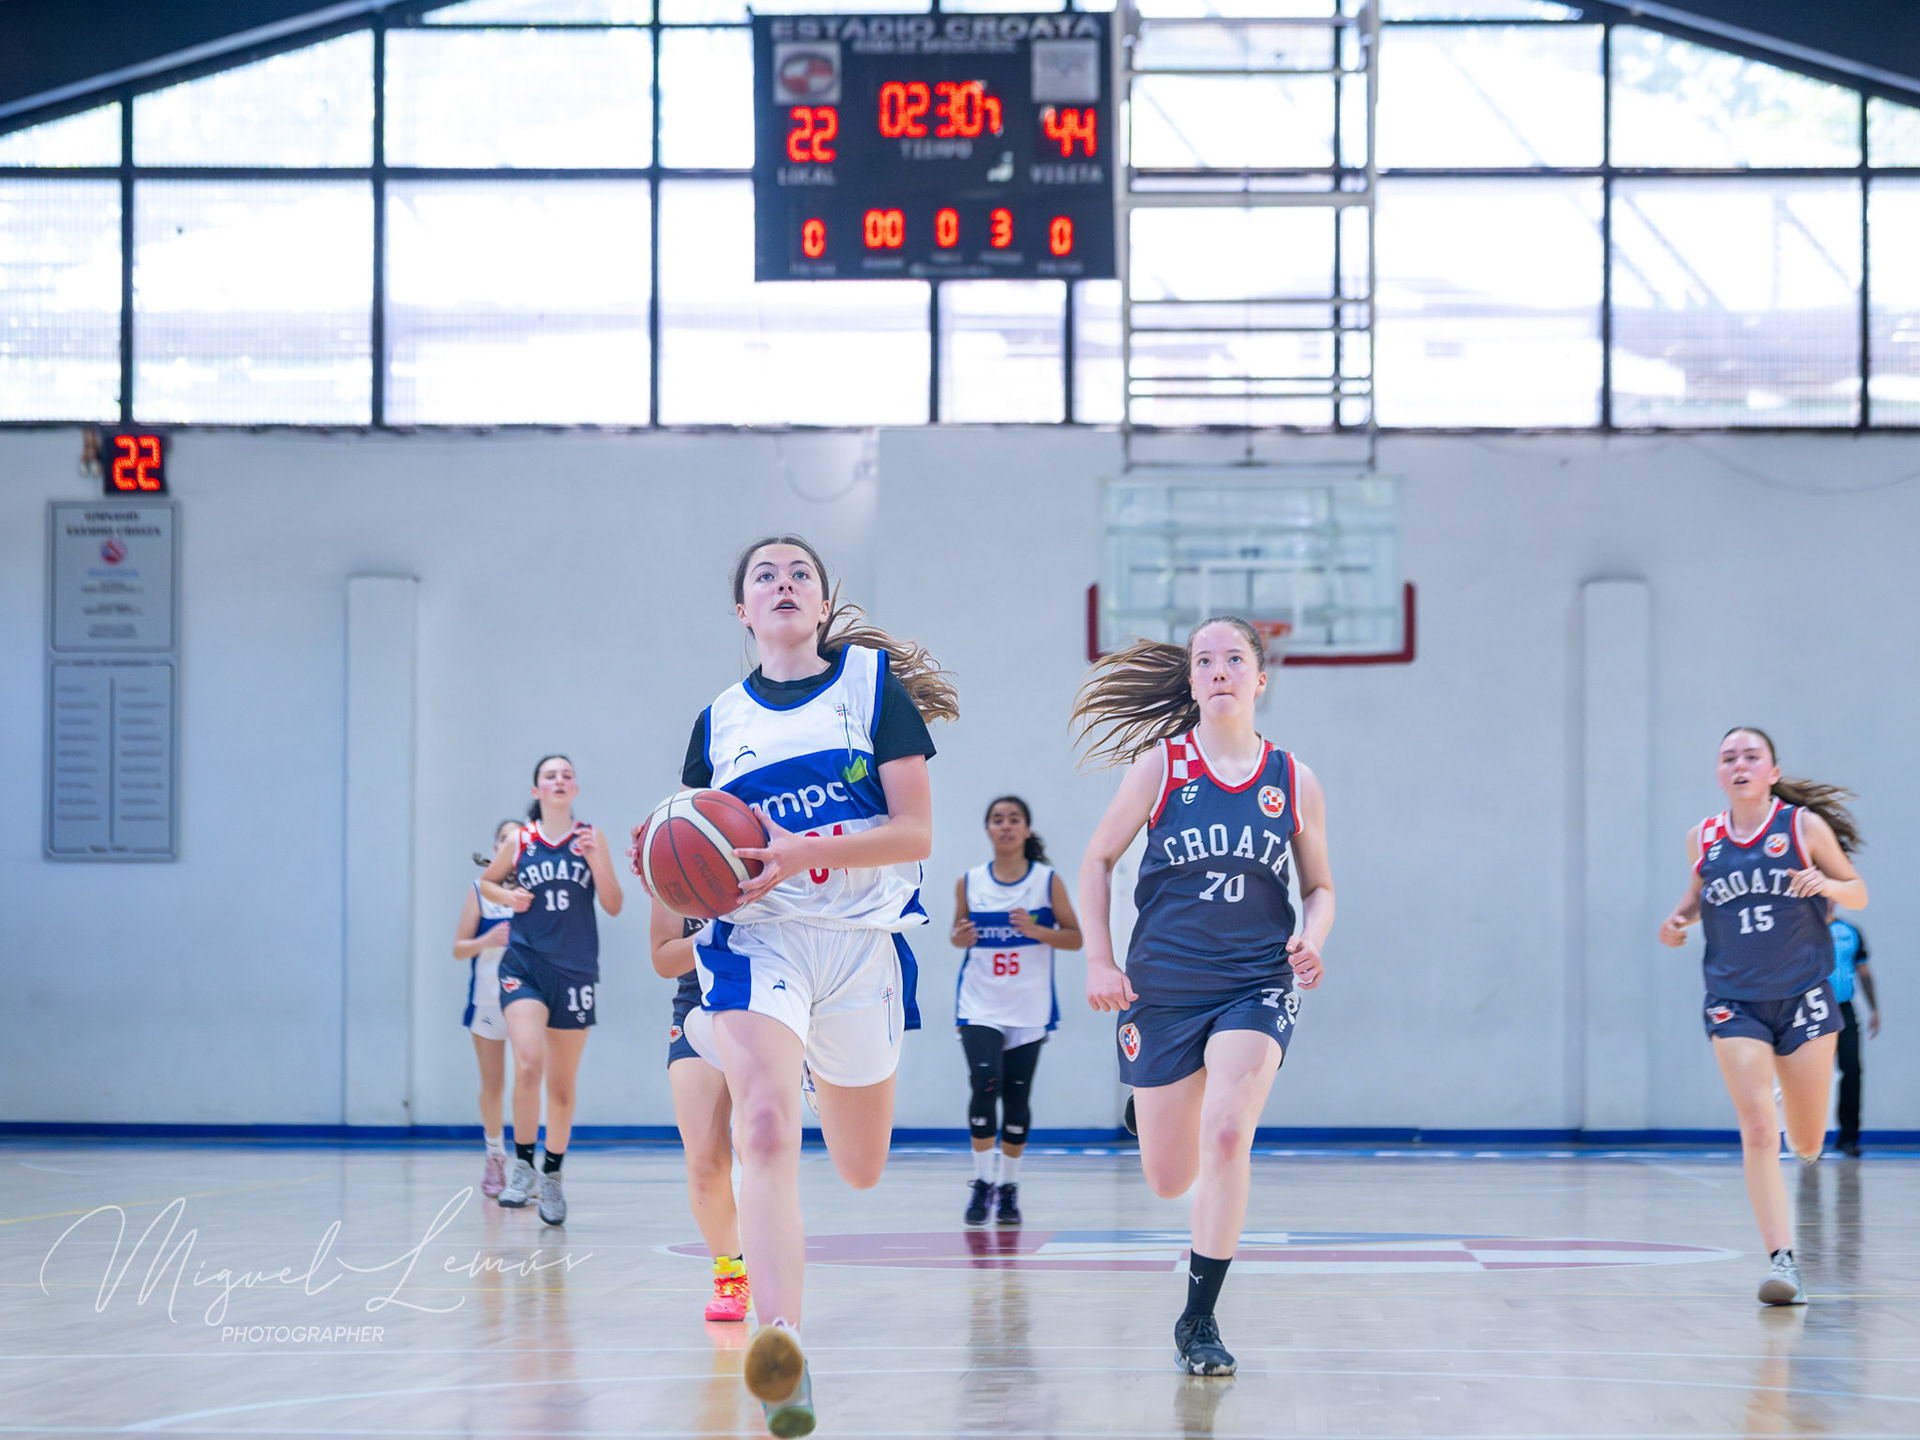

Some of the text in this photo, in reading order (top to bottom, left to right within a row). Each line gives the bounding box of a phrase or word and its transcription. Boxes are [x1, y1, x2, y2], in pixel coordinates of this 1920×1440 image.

[771, 17, 1099, 40] ESTADIO CROATA
[787, 106, 838, 162] 22
[1044, 108, 1096, 157] 44
[802, 218, 825, 258] 0
[864, 208, 905, 248] 00
[935, 208, 958, 248] 0
[990, 208, 1013, 248] 3
[1050, 215, 1073, 255] 0
[112, 435, 161, 490] 22
[1164, 824, 1292, 874] CROATA
[545, 889, 570, 912] 16
[1199, 871, 1245, 903] 70
[1738, 905, 1775, 935] 15
[993, 952, 1019, 976] 66
[567, 985, 593, 1012] 16
[1791, 987, 1829, 1028] 15
